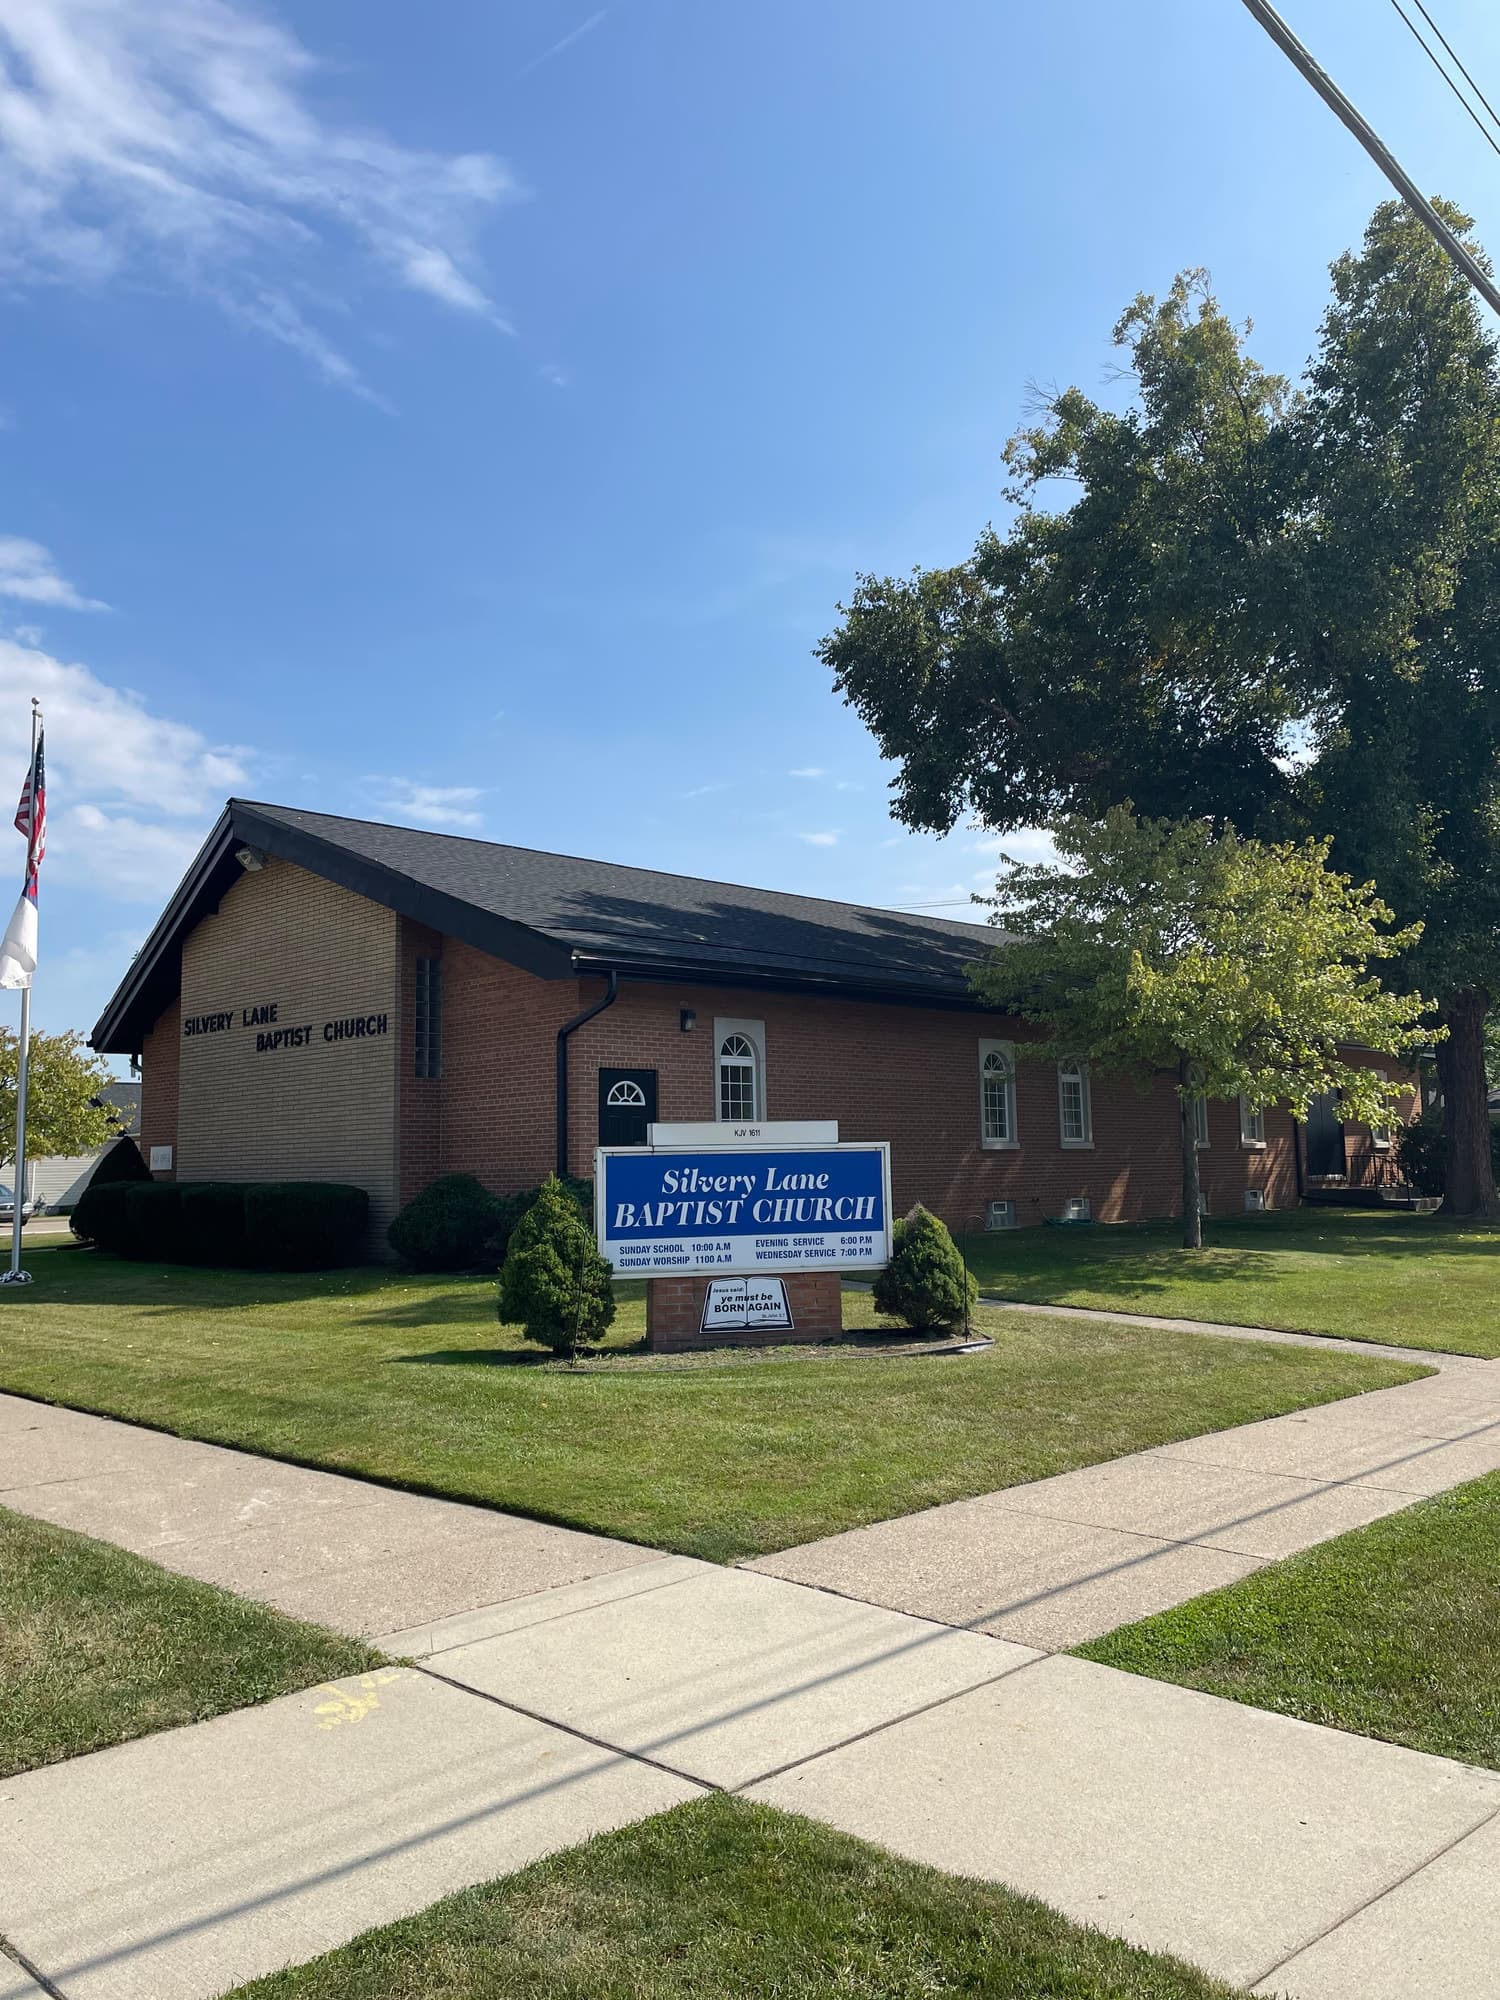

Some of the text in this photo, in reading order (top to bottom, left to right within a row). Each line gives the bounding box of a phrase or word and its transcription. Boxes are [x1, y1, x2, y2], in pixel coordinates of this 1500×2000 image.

[184, 1004, 278, 1036] SILVERY LANE
[256, 1014, 388, 1052] BAPTIST CHURCH
[734, 1128, 761, 1137] KJV 1611
[661, 1167, 829, 1199] Silvery Lane
[613, 1196, 876, 1228] BAPTIST CHURCH
[755, 1238, 789, 1248] EVENING
[792, 1237, 825, 1247] SERVICE
[840, 1236, 858, 1245] 6:00
[619, 1245, 651, 1255] SUNDAY
[653, 1244, 685, 1254] SCHOOL
[692, 1243, 714, 1252] 10:00
[755, 1250, 802, 1260] WEDNESDAY
[804, 1248, 837, 1258] SERVICE
[840, 1247, 858, 1257] 7:00
[619, 1257, 651, 1267] SUNDAY
[653, 1256, 690, 1266] WORSHIP
[721, 1292, 773, 1304] ye must be
[714, 1302, 781, 1313] BORN AGAIN
